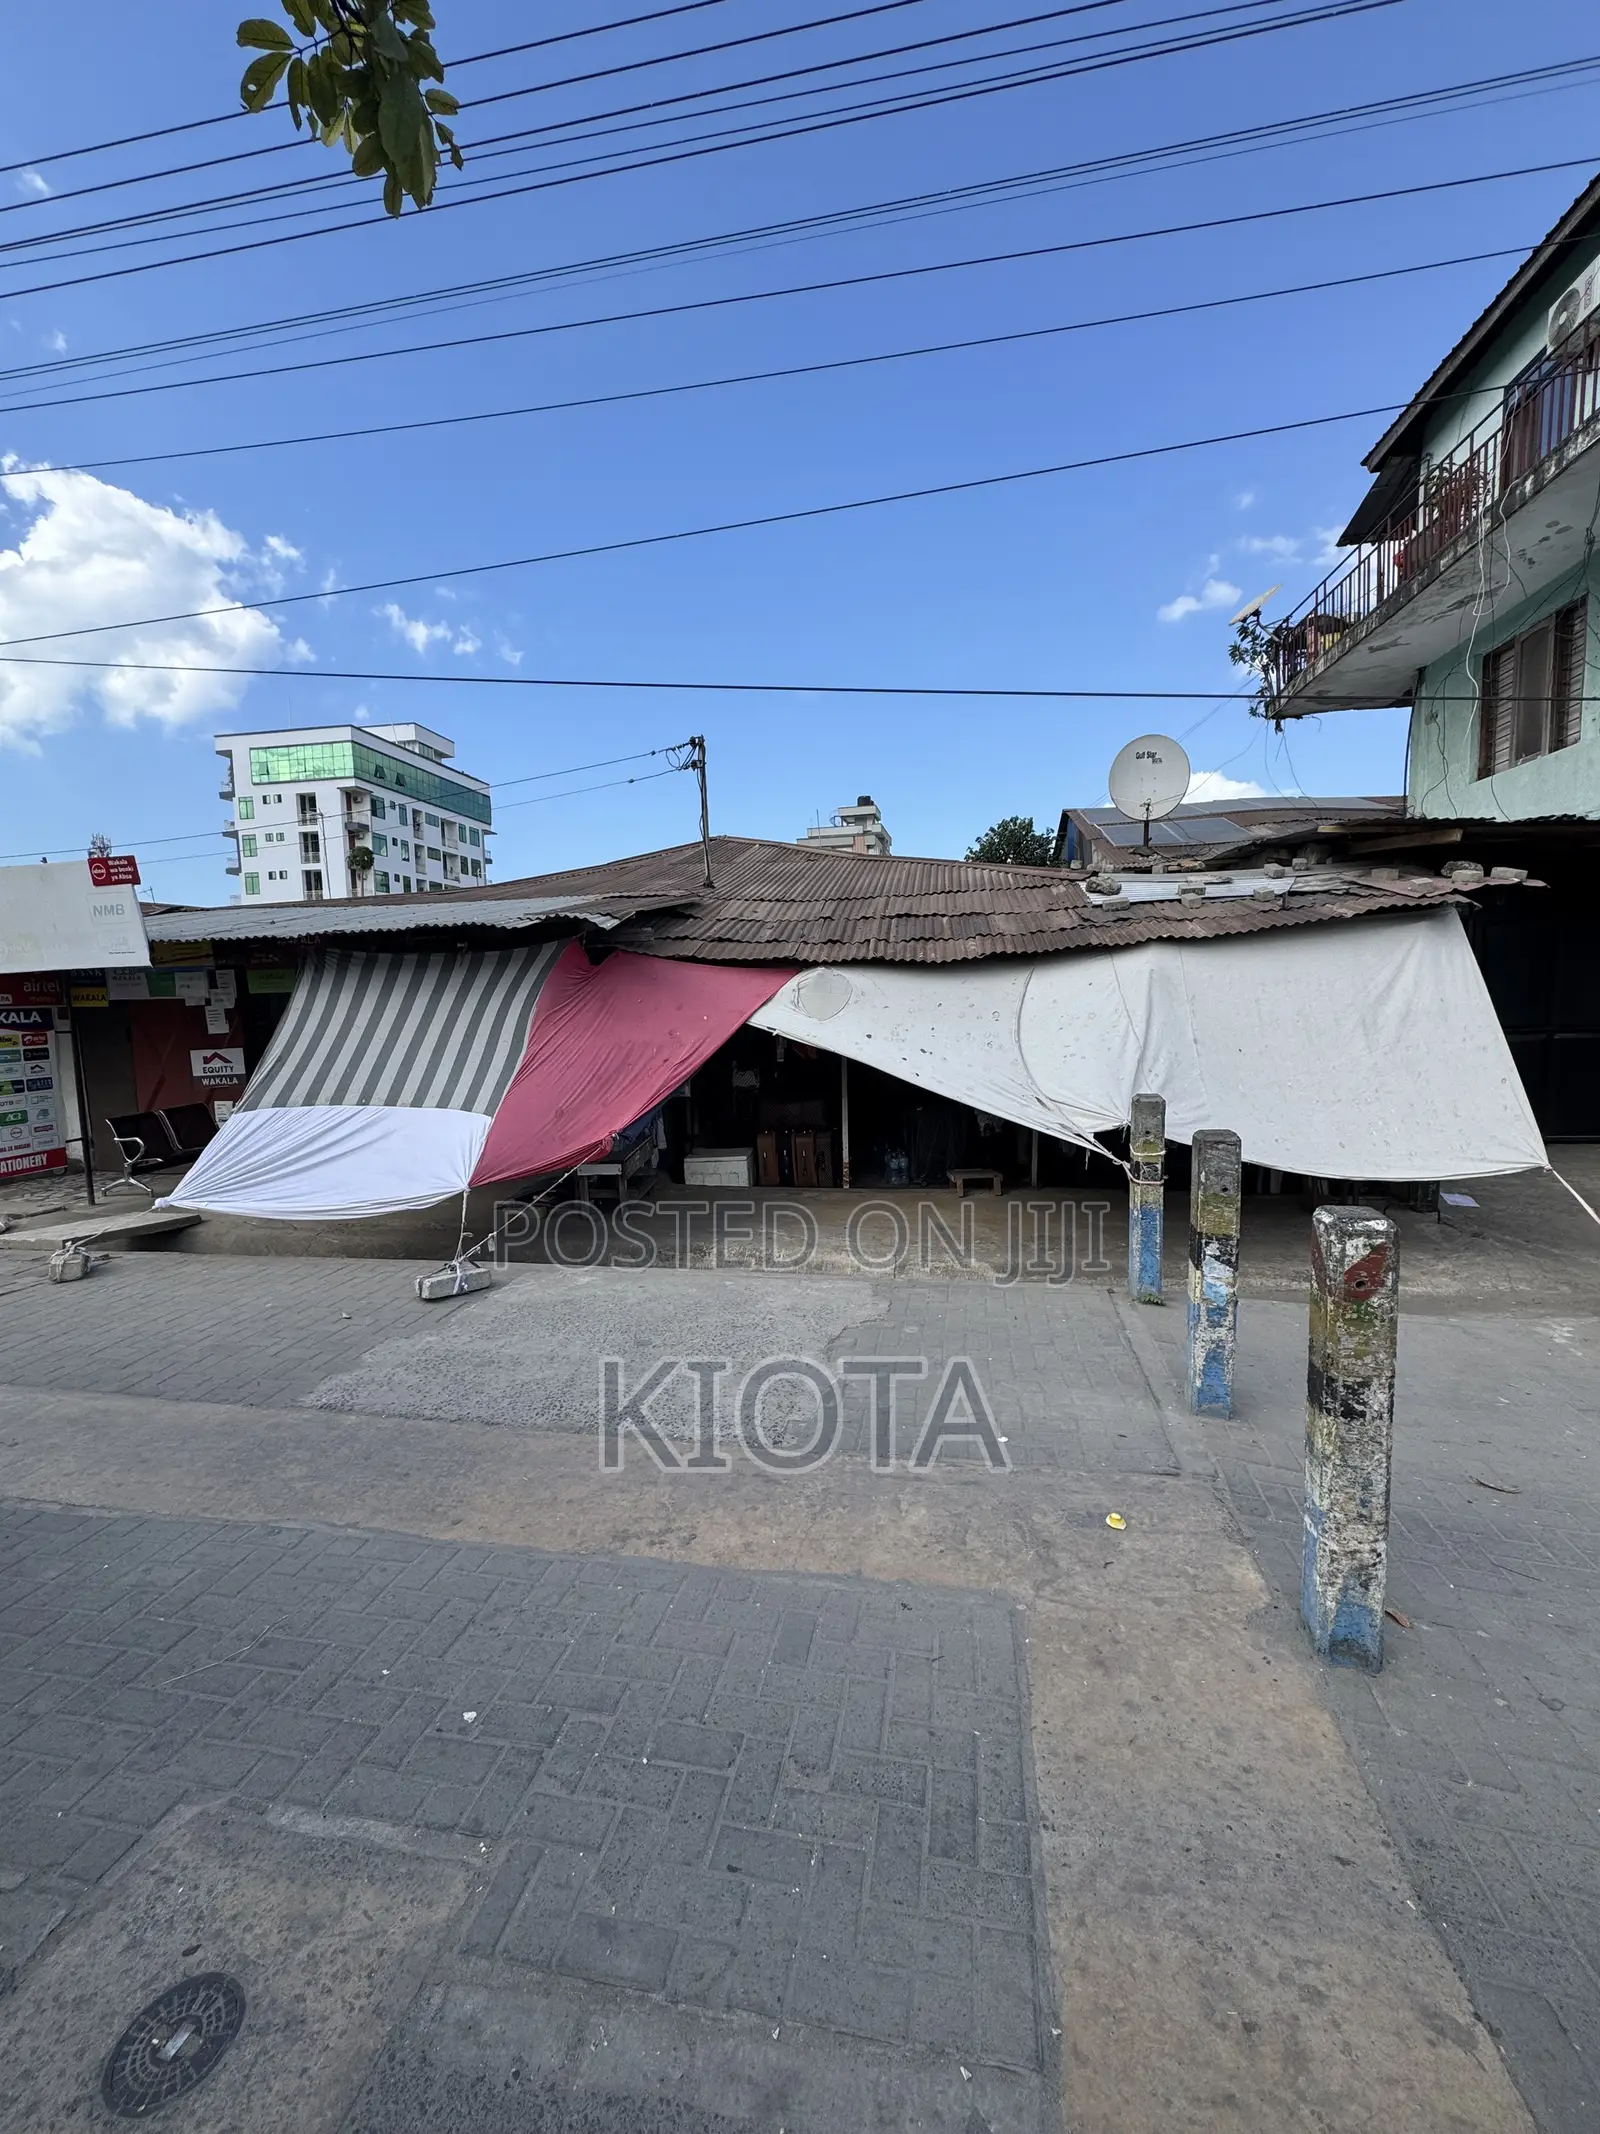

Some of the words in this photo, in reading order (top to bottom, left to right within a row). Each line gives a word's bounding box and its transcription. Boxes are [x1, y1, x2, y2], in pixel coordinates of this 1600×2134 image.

[93, 904, 125, 917] NMB
[22, 979, 61, 993] airtel
[73, 991, 107, 1001] WAKALA
[203, 1066, 234, 1074] EQUITY
[201, 1077, 239, 1086] WAKALA
[0, 1153, 47, 1174] ATIONERY
